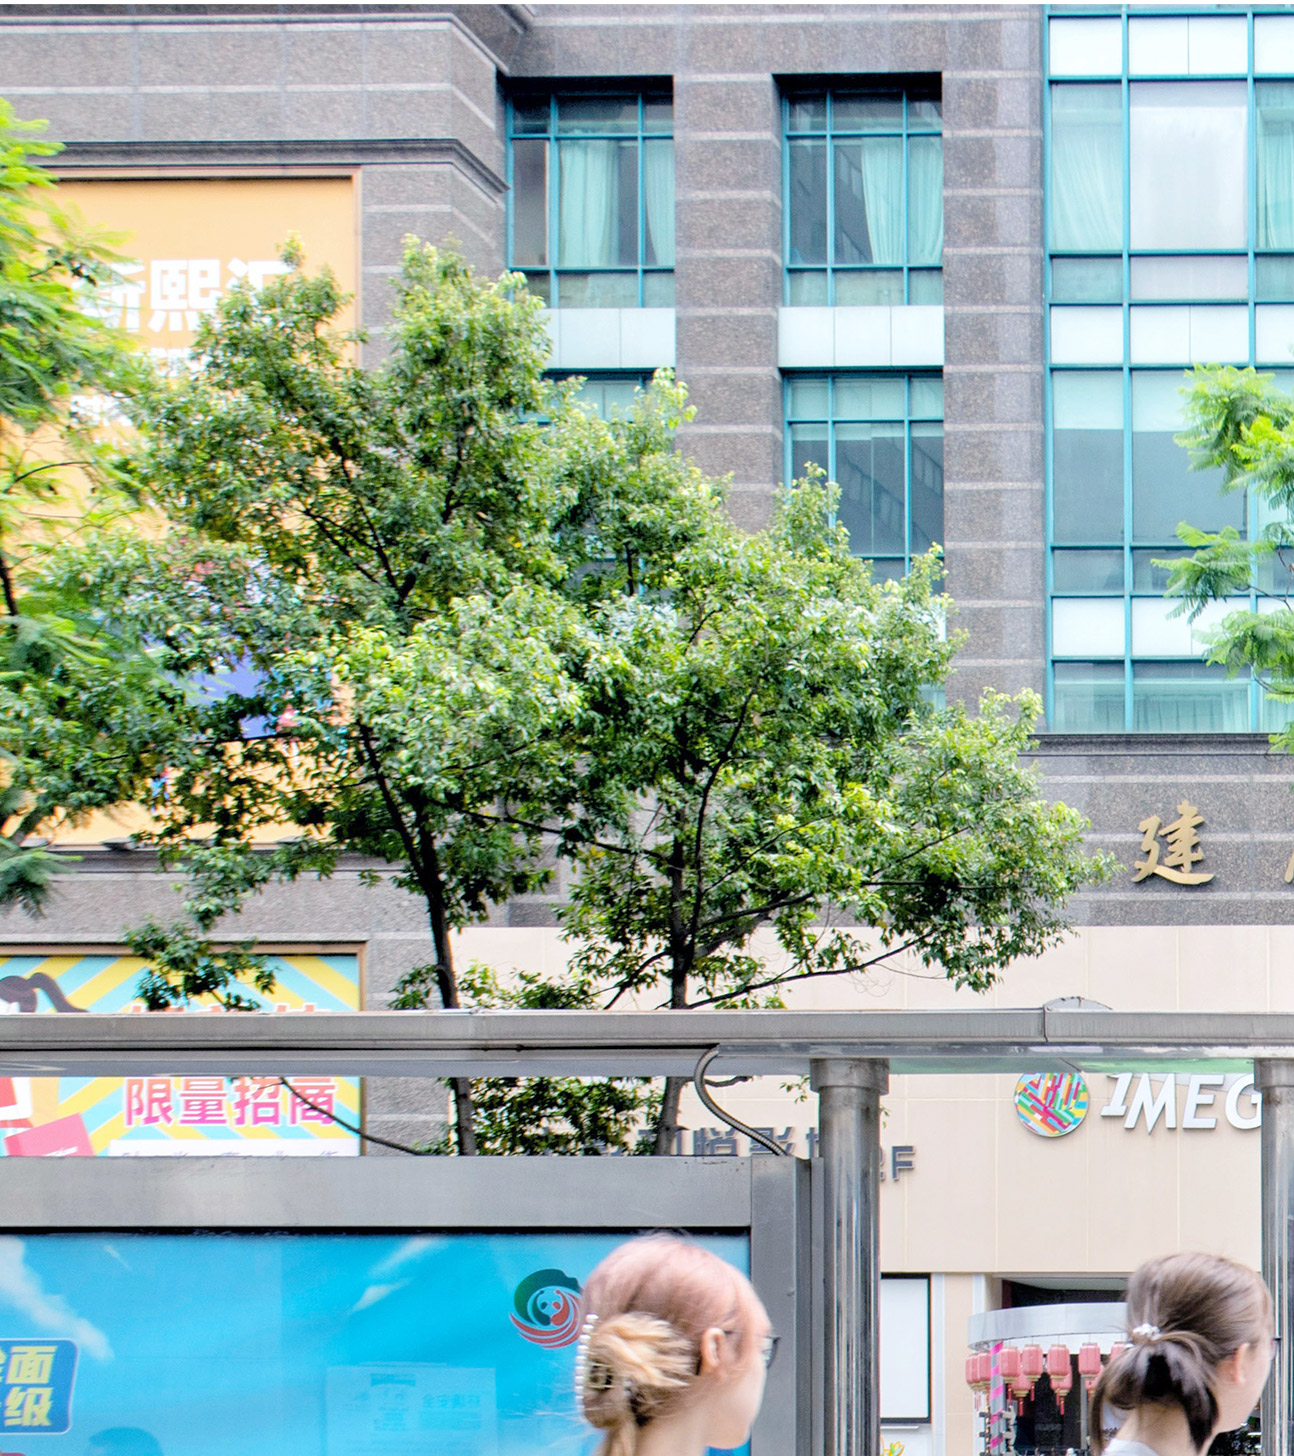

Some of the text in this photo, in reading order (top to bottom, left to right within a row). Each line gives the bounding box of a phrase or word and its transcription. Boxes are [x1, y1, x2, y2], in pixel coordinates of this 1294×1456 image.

[125, 1076, 336, 1127] 限量招商
[0, 1345, 58, 1385] 面
[0, 1386, 55, 1427] 级
